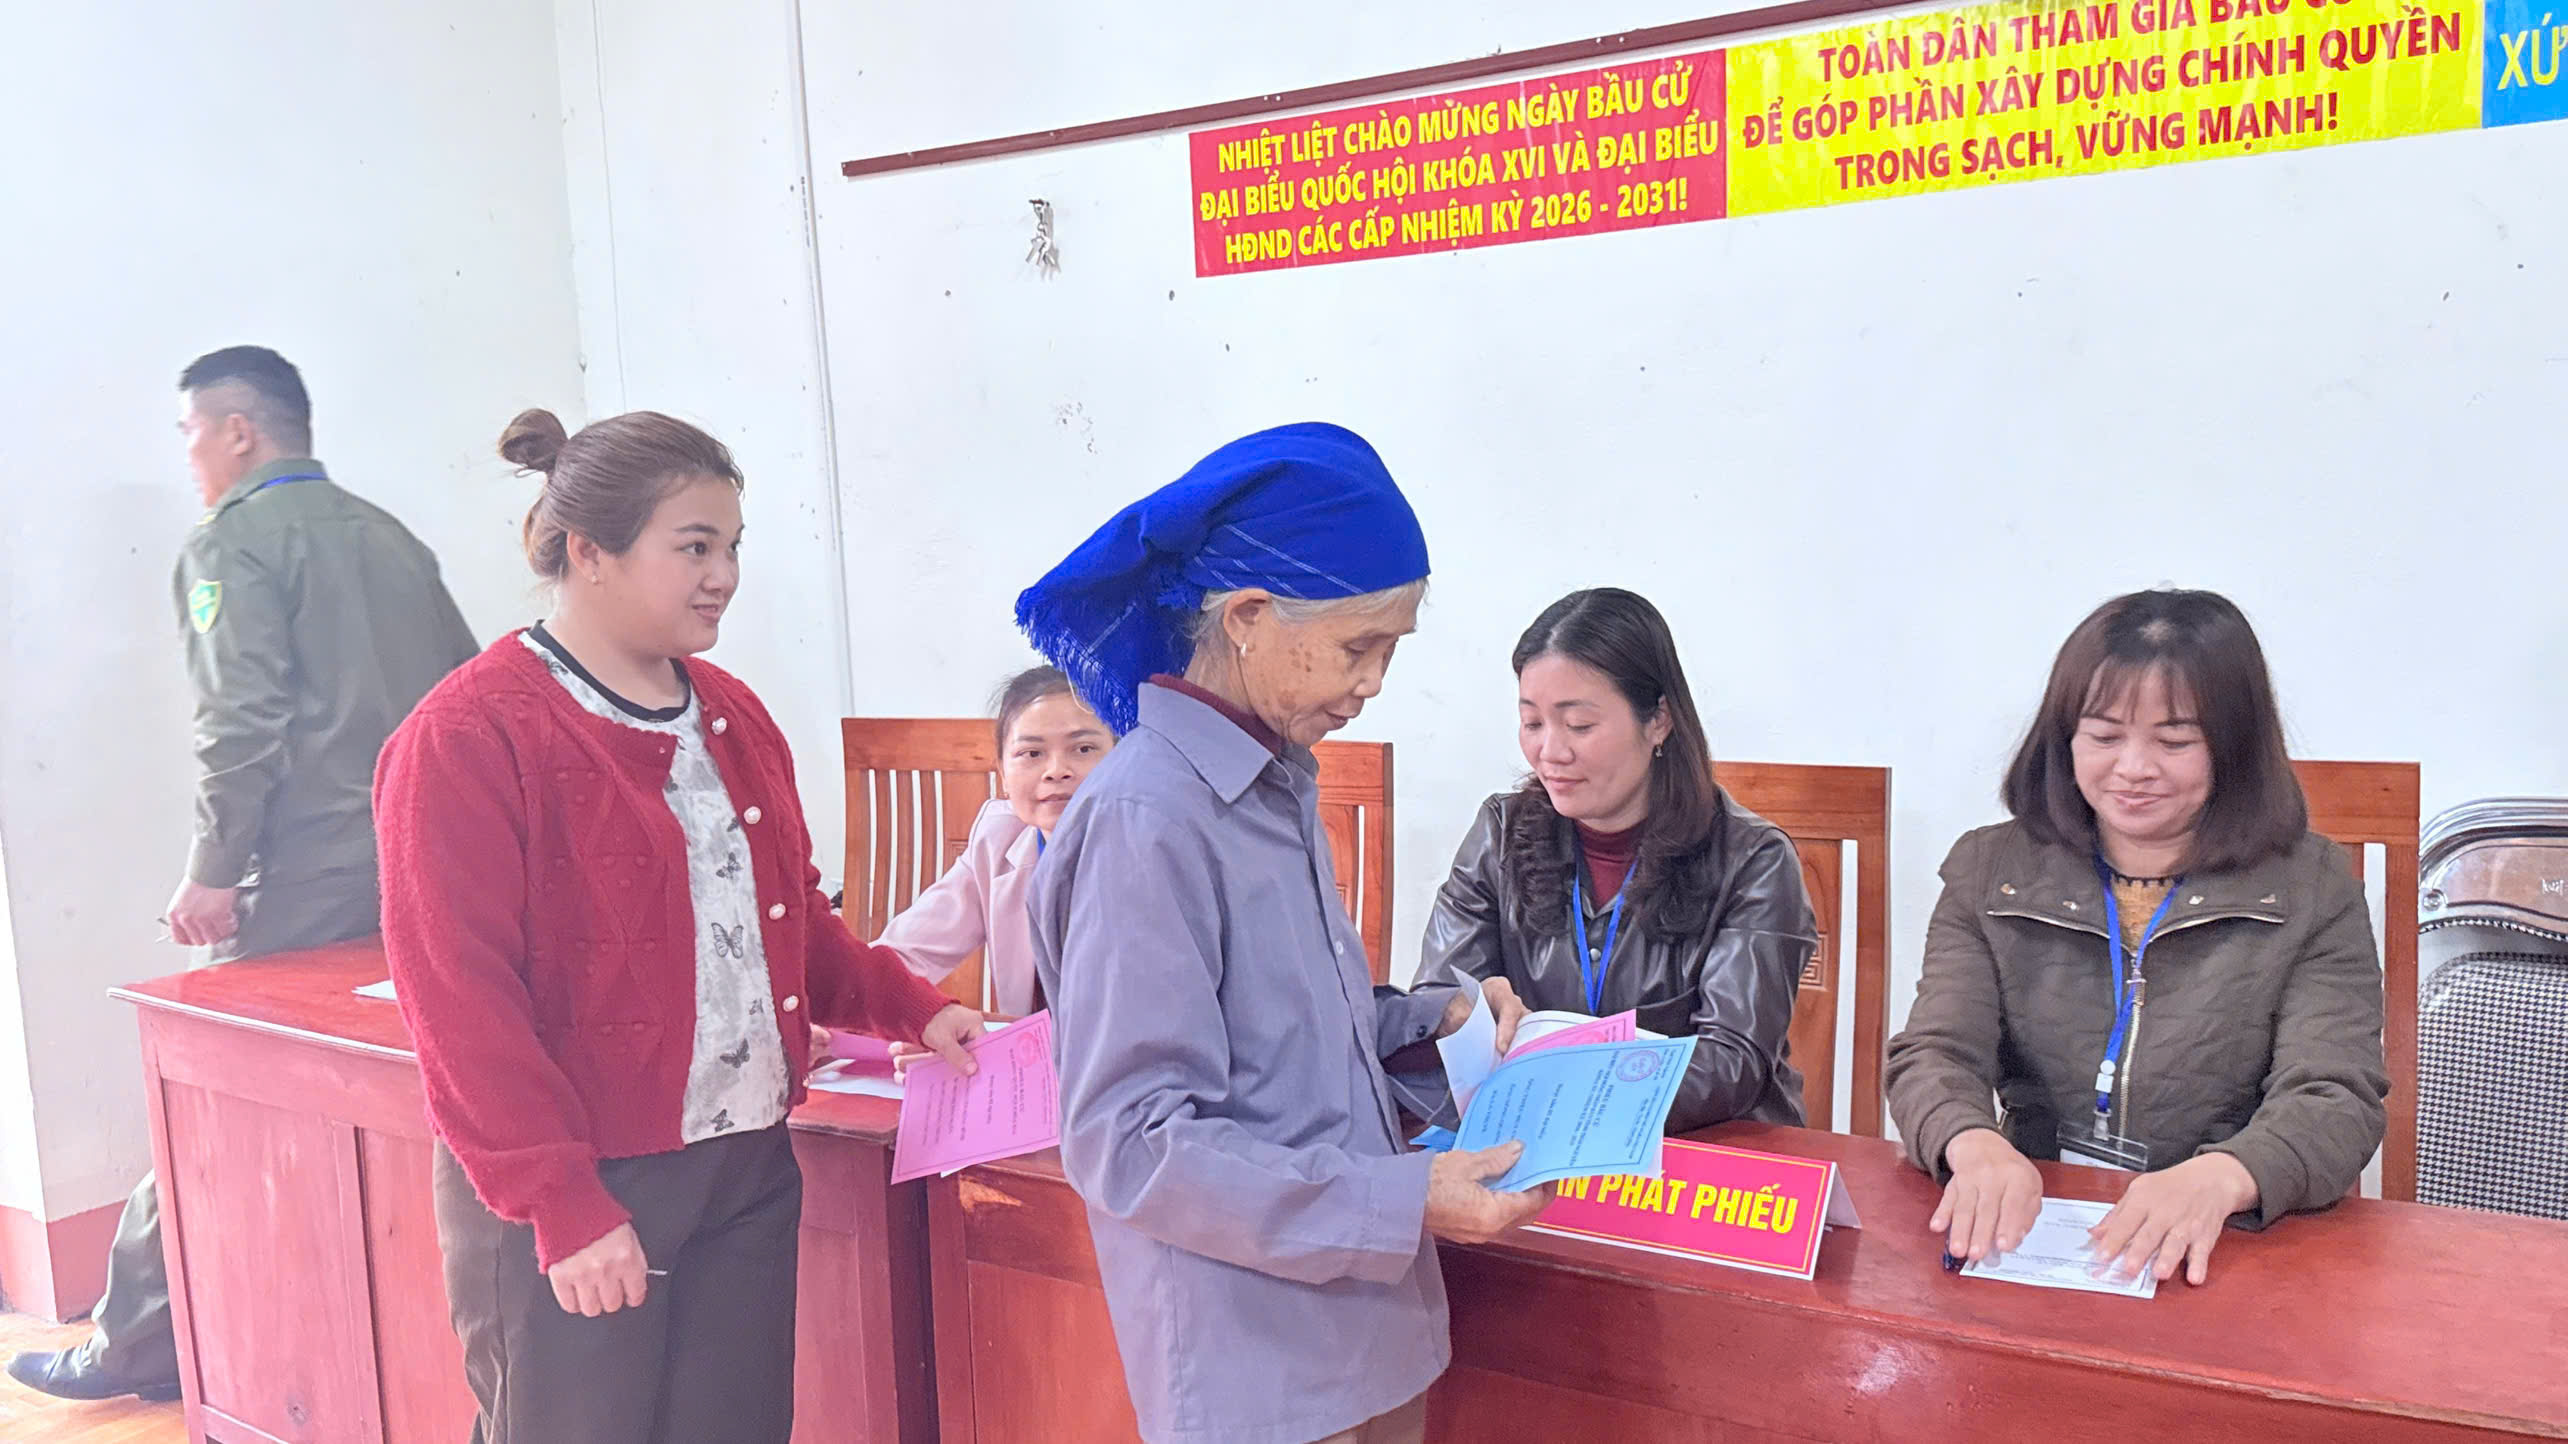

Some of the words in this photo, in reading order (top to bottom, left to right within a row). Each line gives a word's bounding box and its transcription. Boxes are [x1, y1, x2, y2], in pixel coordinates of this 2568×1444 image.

[1743, 97, 1784, 148] ĐỂ
[1792, 93, 1858, 141] GÓP
[1868, 77, 1964, 131] PHẦN
[1976, 66, 2044, 116] XÂY
[2057, 56, 2167, 110] DỰNG
[2178, 32, 2305, 86] CHÍNH
[2319, 5, 2461, 72] QUYỀN
[1818, 31, 1910, 82] TOÀN
[1922, 17, 1997, 66] DÂN
[2008, 2, 2119, 52] THAM
[2130, 0, 2196, 35] GIA
[1218, 128, 1286, 176] NHIỆT
[1292, 119, 1337, 167] LIỆT
[1343, 110, 1412, 155] CHÀO
[1418, 99, 1500, 144] MỪNG
[1506, 83, 1579, 130] NGÀY
[1586, 73, 1643, 118] BẦU
[1651, 59, 1693, 108] CỬ
[1834, 143, 1950, 190] TRONG
[1961, 129, 2064, 181] SẠCH,
[2076, 109, 2185, 159] VỮNG
[2199, 92, 2338, 150] MẠNH!
[1200, 189, 1240, 226] ĐẠI
[1245, 168, 1295, 215] BIỂU
[1301, 161, 1366, 210] QUỐC
[1373, 156, 1416, 204] HỘI
[1423, 147, 1495, 192] KHÓA
[1502, 146, 1545, 182] XVI
[1552, 131, 1591, 176] VÀ
[1596, 134, 1646, 174] ĐẠI
[1654, 108, 1719, 160] BIỂU
[1297, 214, 1342, 256] CÁC
[1348, 206, 1395, 251] CẤP
[1401, 200, 1484, 246] NHIỆM
[1491, 191, 1523, 234] KỲ
[1530, 190, 1592, 229] 2026
[1616, 178, 1687, 217] 2031!
[1596, 1170, 1687, 1215] PHÁT
[1690, 1183, 1798, 1234] PHIẾU
